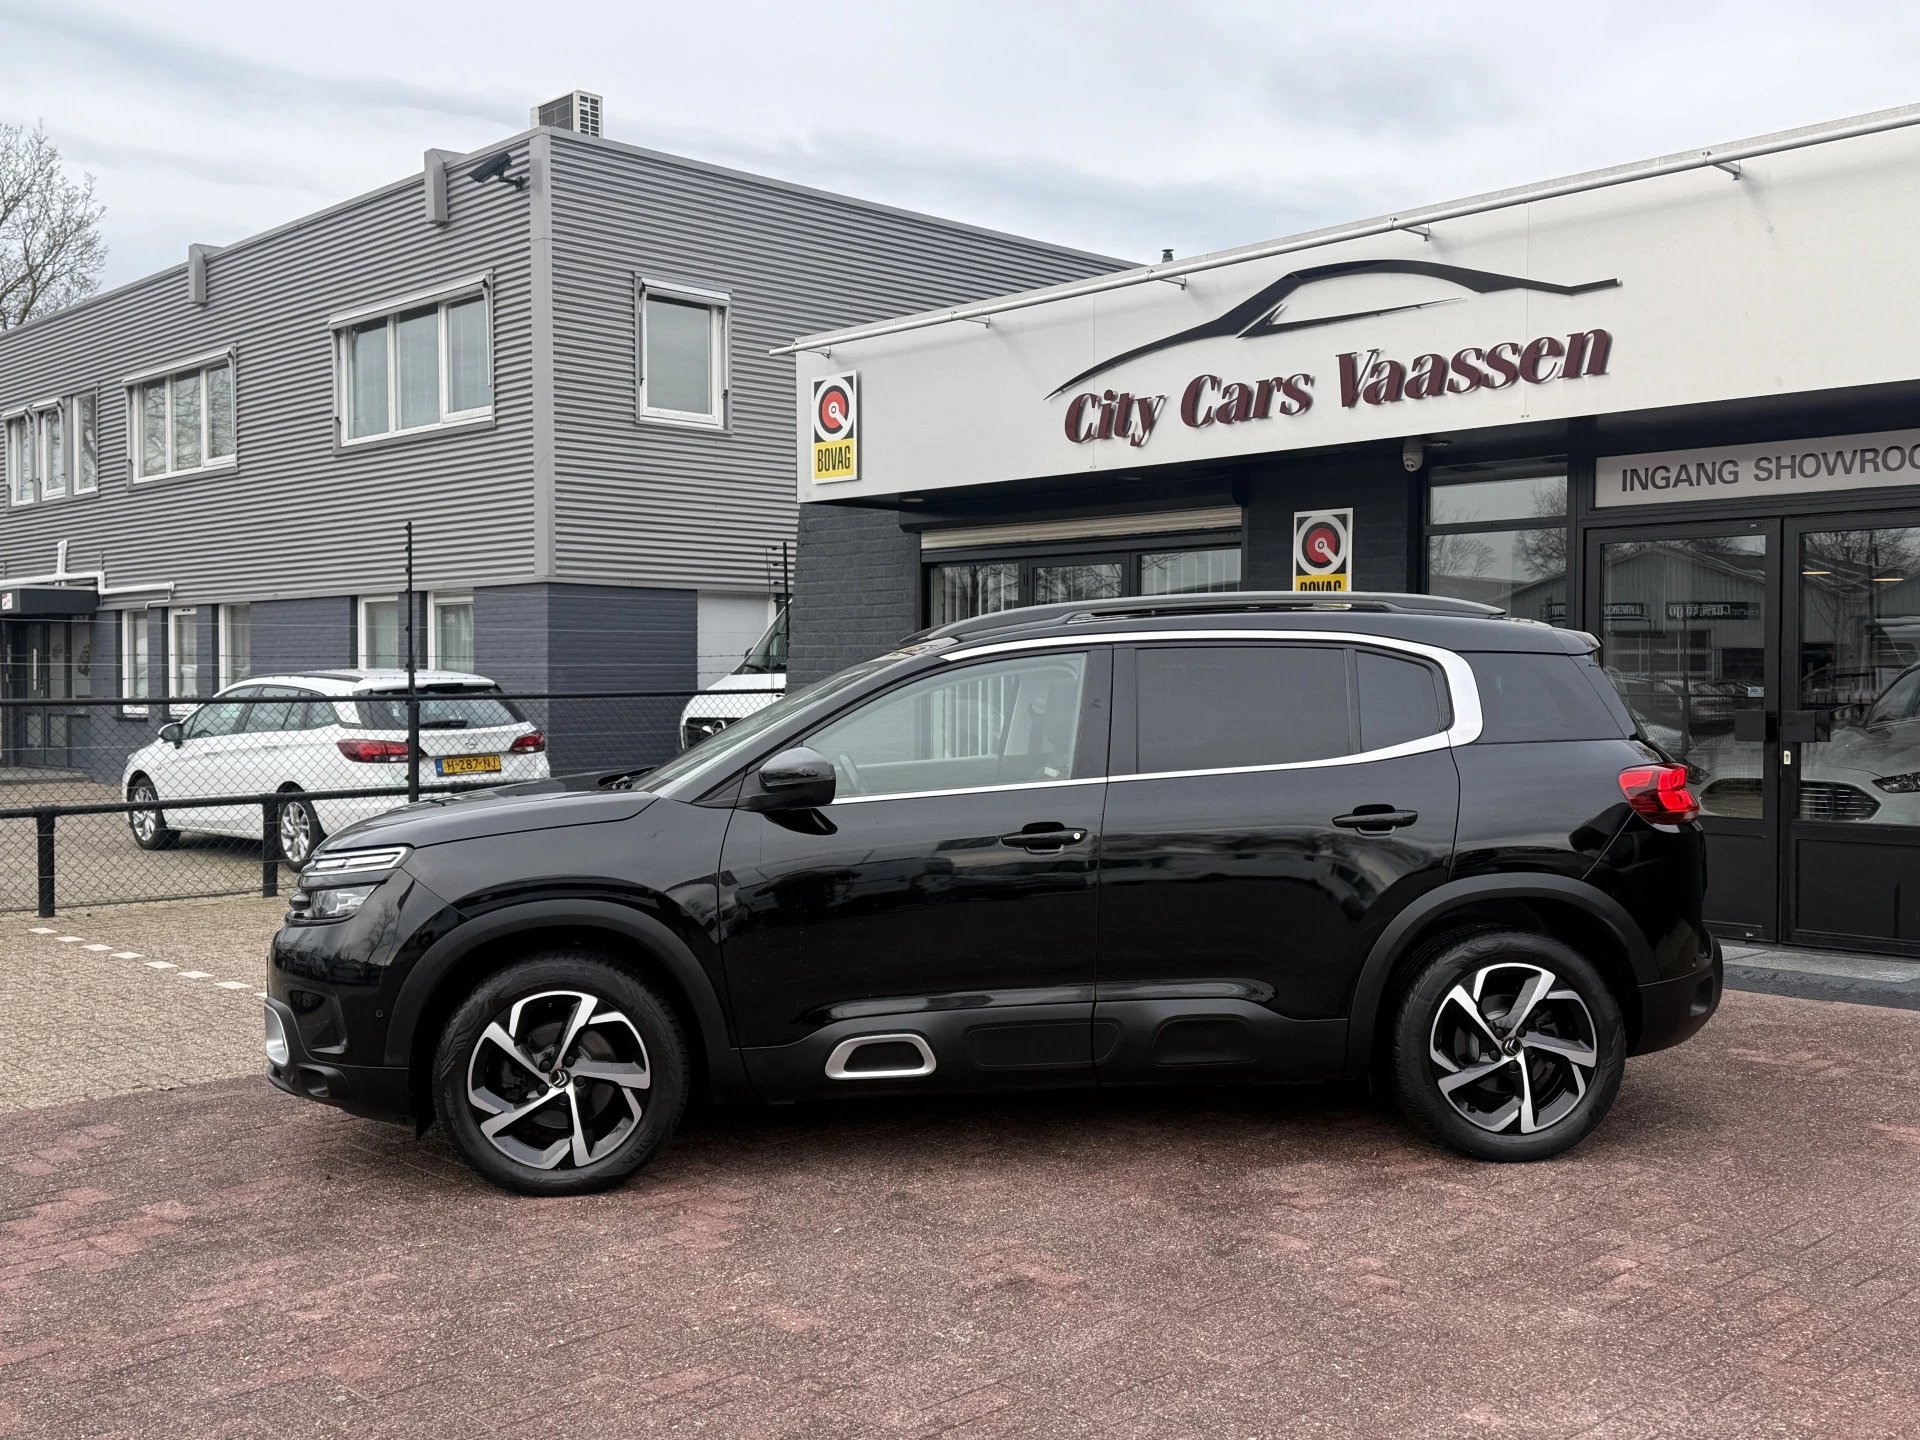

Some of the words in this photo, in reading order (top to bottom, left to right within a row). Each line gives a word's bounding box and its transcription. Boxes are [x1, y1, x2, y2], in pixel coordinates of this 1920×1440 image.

[1064, 389, 1168, 448] City
[1180, 373, 1312, 428] Cars
[1335, 327, 1613, 408] Vaassen
[817, 445, 851, 472] BOVAG
[1621, 459, 1740, 492] INGANG
